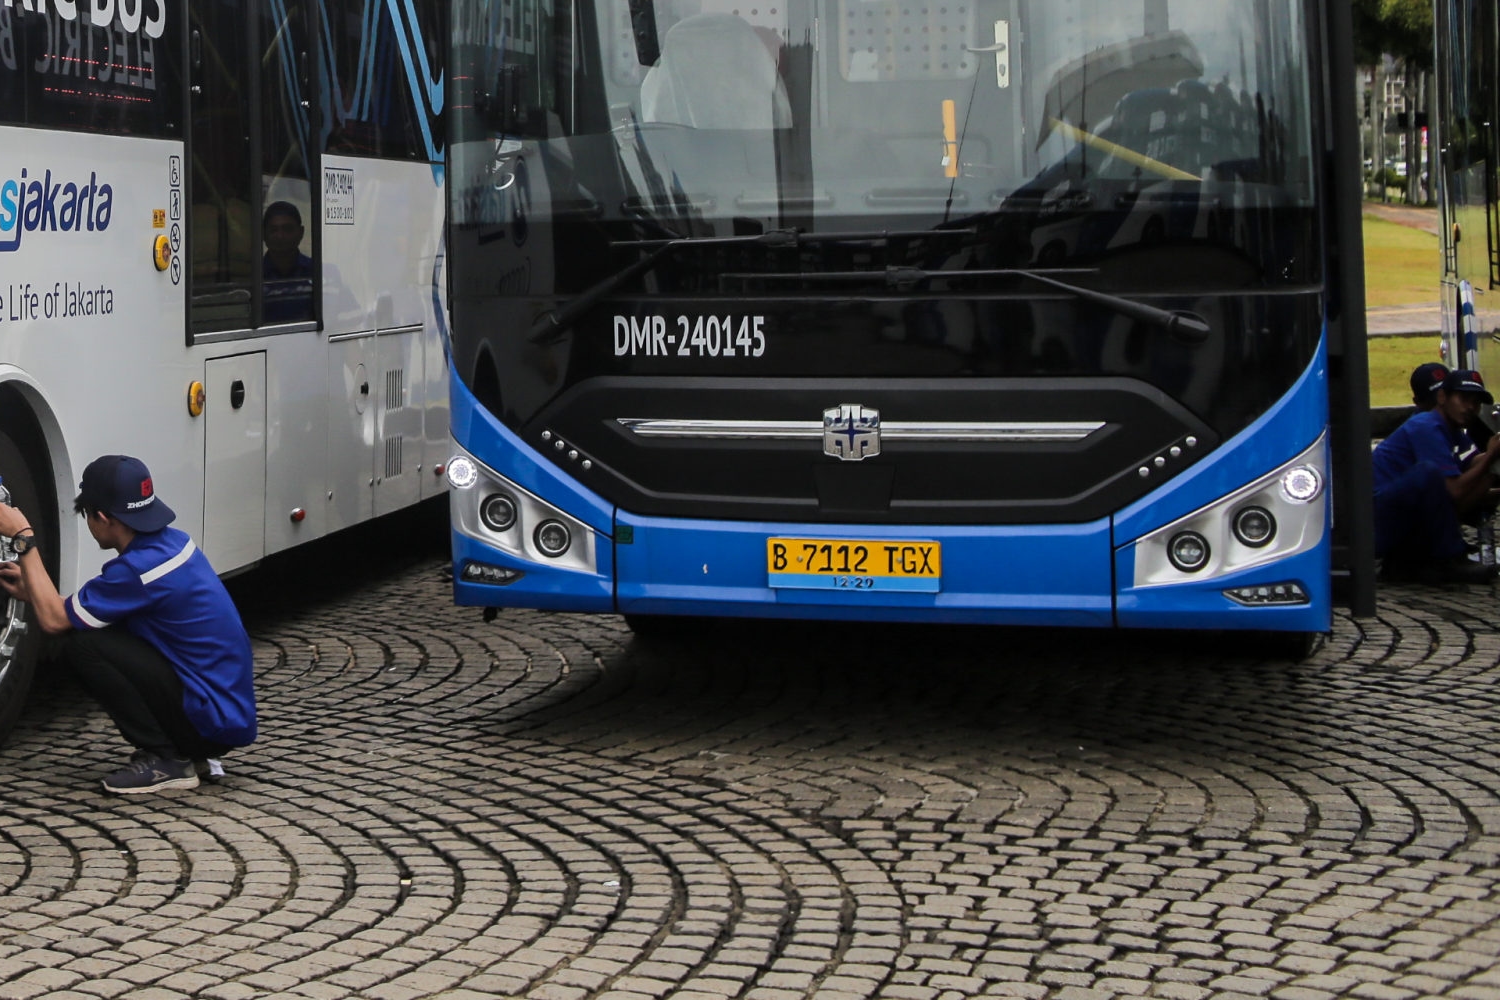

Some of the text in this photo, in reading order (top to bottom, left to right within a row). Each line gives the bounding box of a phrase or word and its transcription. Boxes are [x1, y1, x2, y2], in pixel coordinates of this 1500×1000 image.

[9, 283, 39, 322] Life
[44, 282, 60, 318] of
[62, 281, 114, 317] Jakarta
[613, 314, 766, 357] DMR-240145
[772, 543, 935, 575] B 7112 TGX
